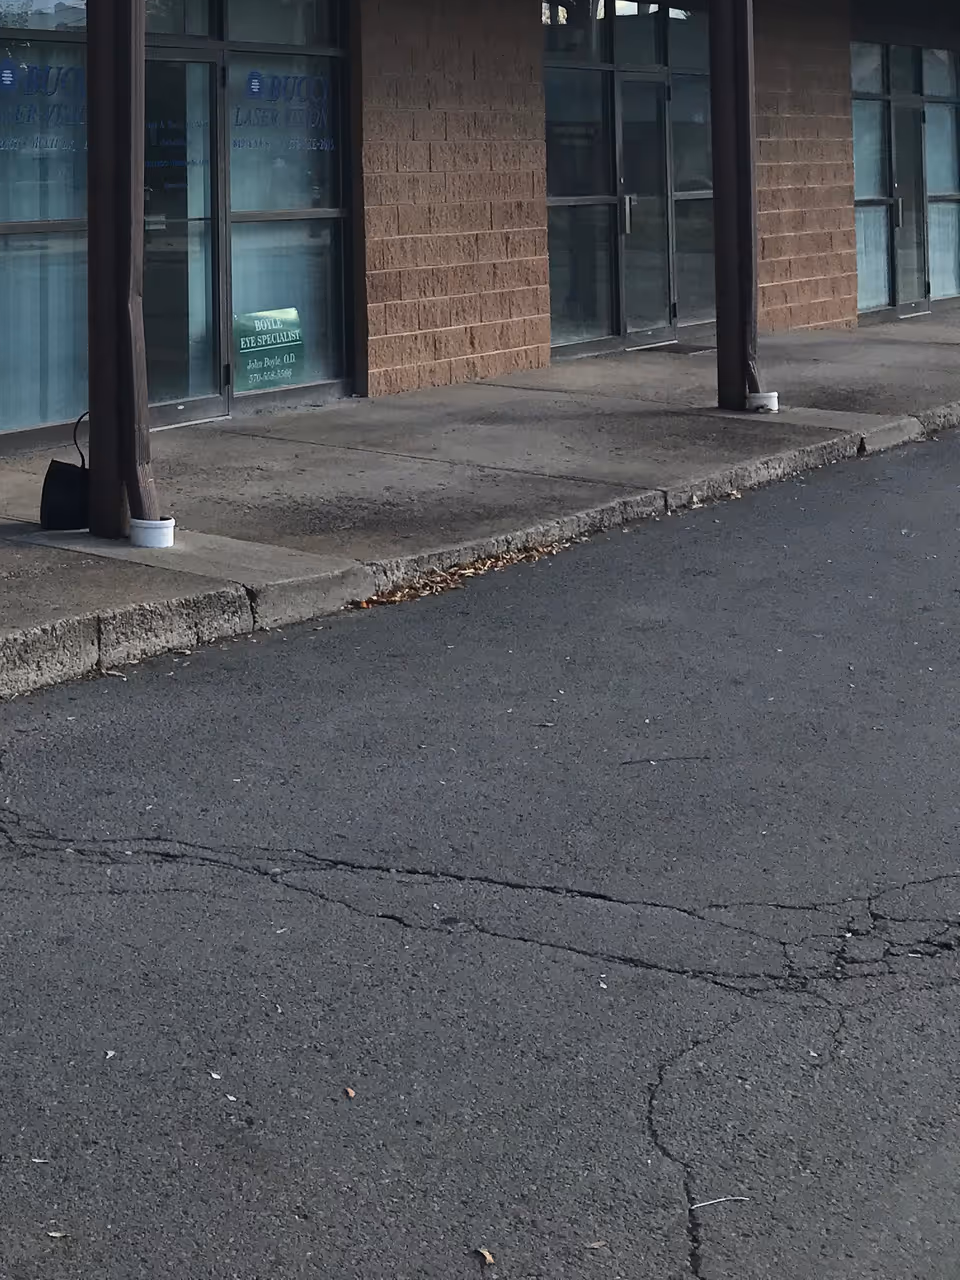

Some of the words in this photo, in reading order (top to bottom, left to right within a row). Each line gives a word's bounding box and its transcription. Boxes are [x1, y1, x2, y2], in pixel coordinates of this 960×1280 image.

[254, 318, 283, 331] BOYLE
[240, 336, 256, 348] EYE
[257, 329, 301, 346] SPECIALIST
[247, 357, 263, 369] John
